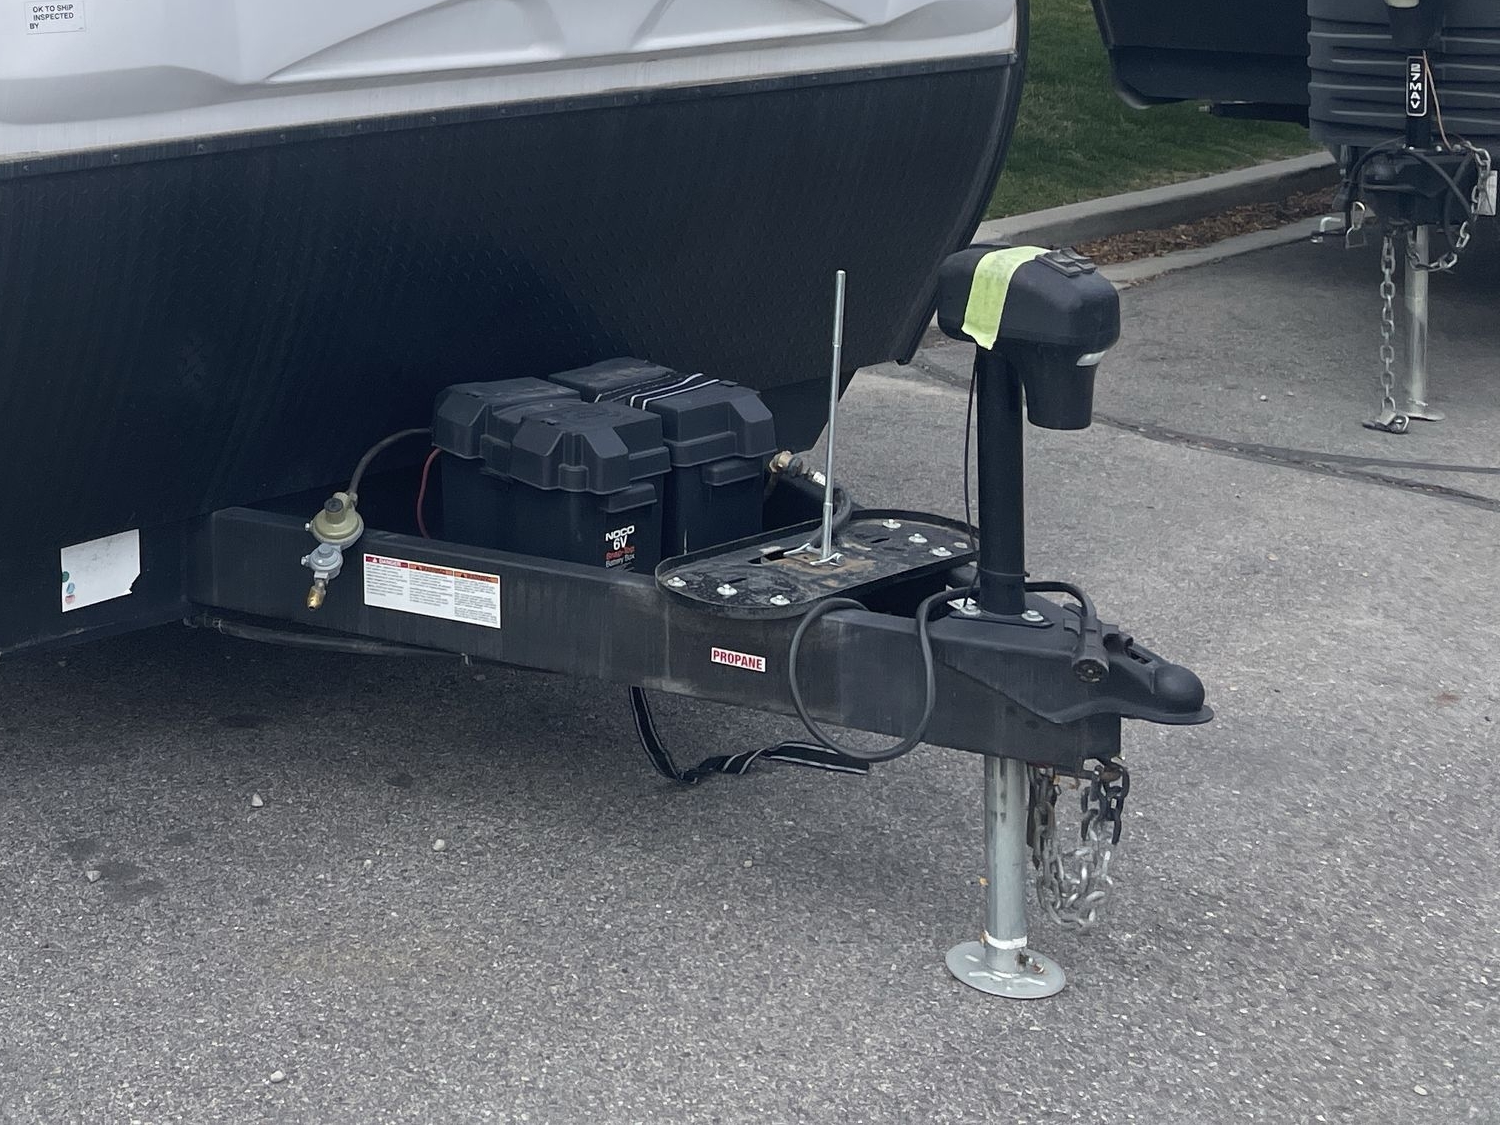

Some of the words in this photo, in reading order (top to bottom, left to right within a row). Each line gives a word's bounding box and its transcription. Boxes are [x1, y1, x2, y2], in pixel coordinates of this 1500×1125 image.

[45, 5, 56, 13] TO
[56, 4, 74, 12] SHIP
[33, 12, 74, 21] INSPECTED
[29, 22, 40, 30] BY
[605, 525, 635, 542] NOCO
[613, 534, 628, 551] 6V
[712, 649, 763, 670] PROPANE
